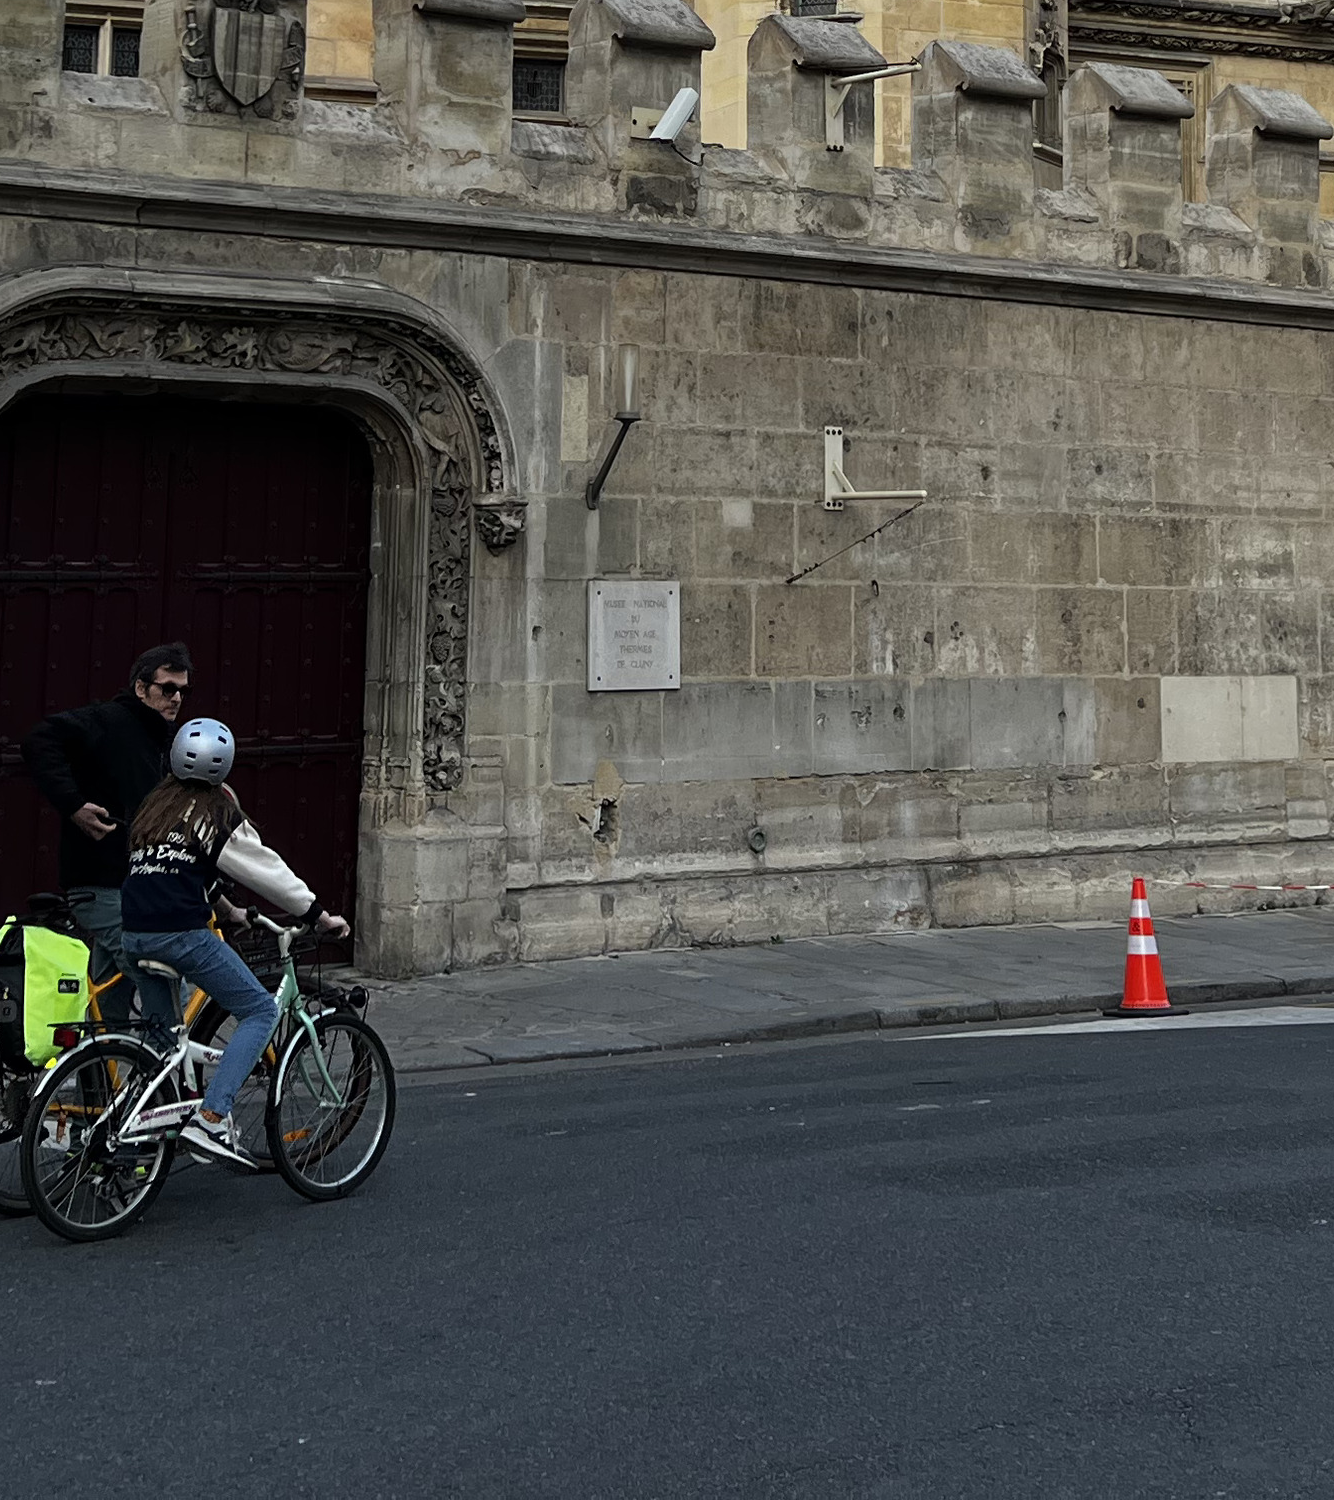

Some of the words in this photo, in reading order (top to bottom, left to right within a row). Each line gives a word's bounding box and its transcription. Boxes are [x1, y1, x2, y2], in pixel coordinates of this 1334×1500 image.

[633, 600, 667, 609] NATIONAL
[631, 614, 641, 624] DU
[614, 630, 639, 639] MOYEN
[619, 645, 653, 654] THERMES
[616, 660, 626, 669] DE
[630, 660, 654, 669] CLUNY
[156, 844, 197, 864] Explore
